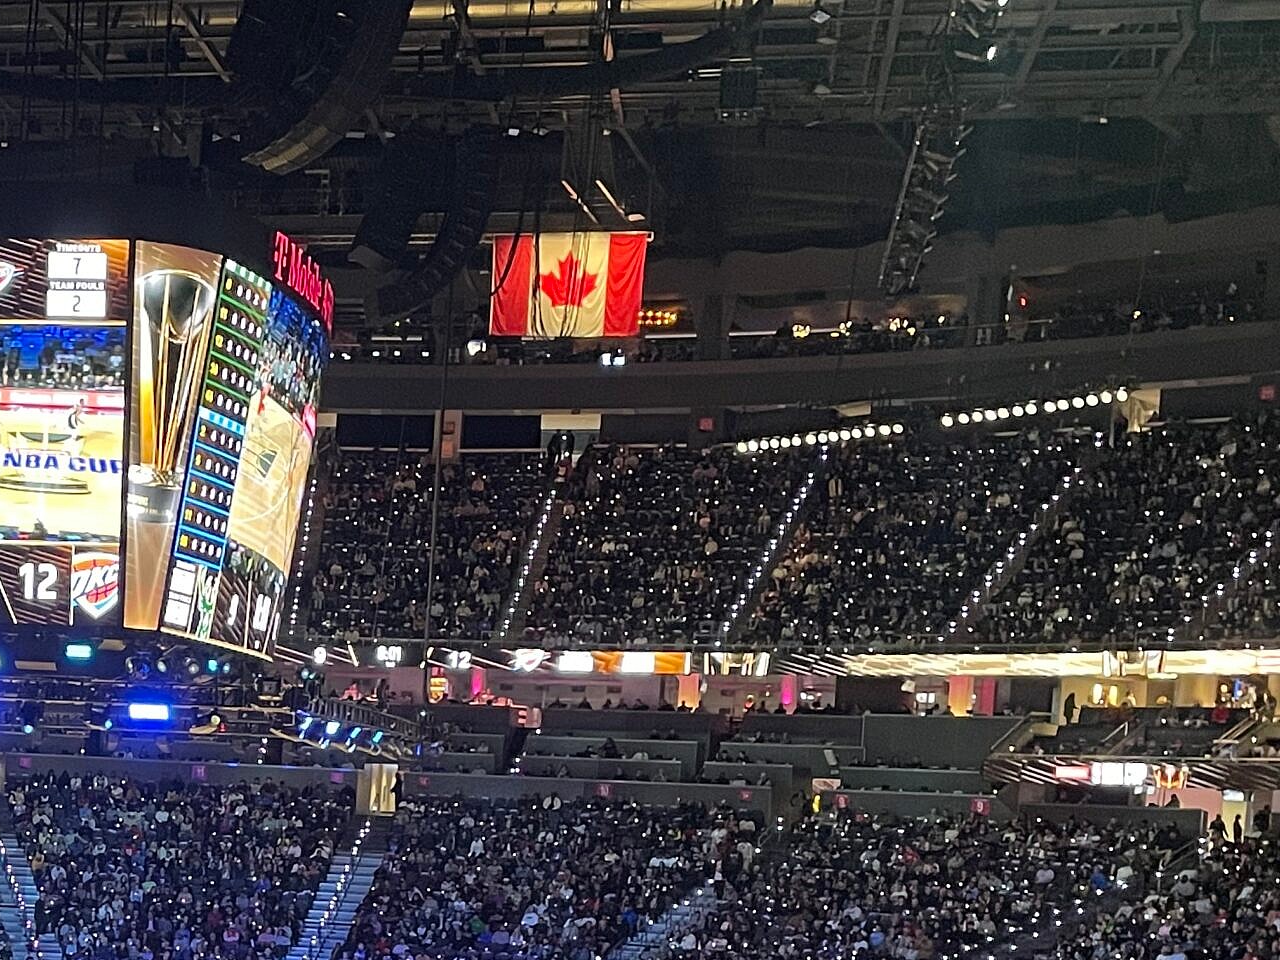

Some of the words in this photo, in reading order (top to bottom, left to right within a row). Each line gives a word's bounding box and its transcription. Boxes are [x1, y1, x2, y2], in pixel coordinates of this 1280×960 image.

[56, 244, 101, 252] TIMEOUTS
[73, 257, 81, 275] 7
[49, 281, 75, 289] TEAM
[76, 281, 105, 290] FOULS
[73, 295, 80, 312] 2
[3, 453, 59, 469] NBA
[68, 457, 122, 474] CUP
[20, 563, 58, 600] 12
[314, 646, 326, 664] 9
[448, 651, 472, 668] 12
[976, 800, 983, 812] 9
